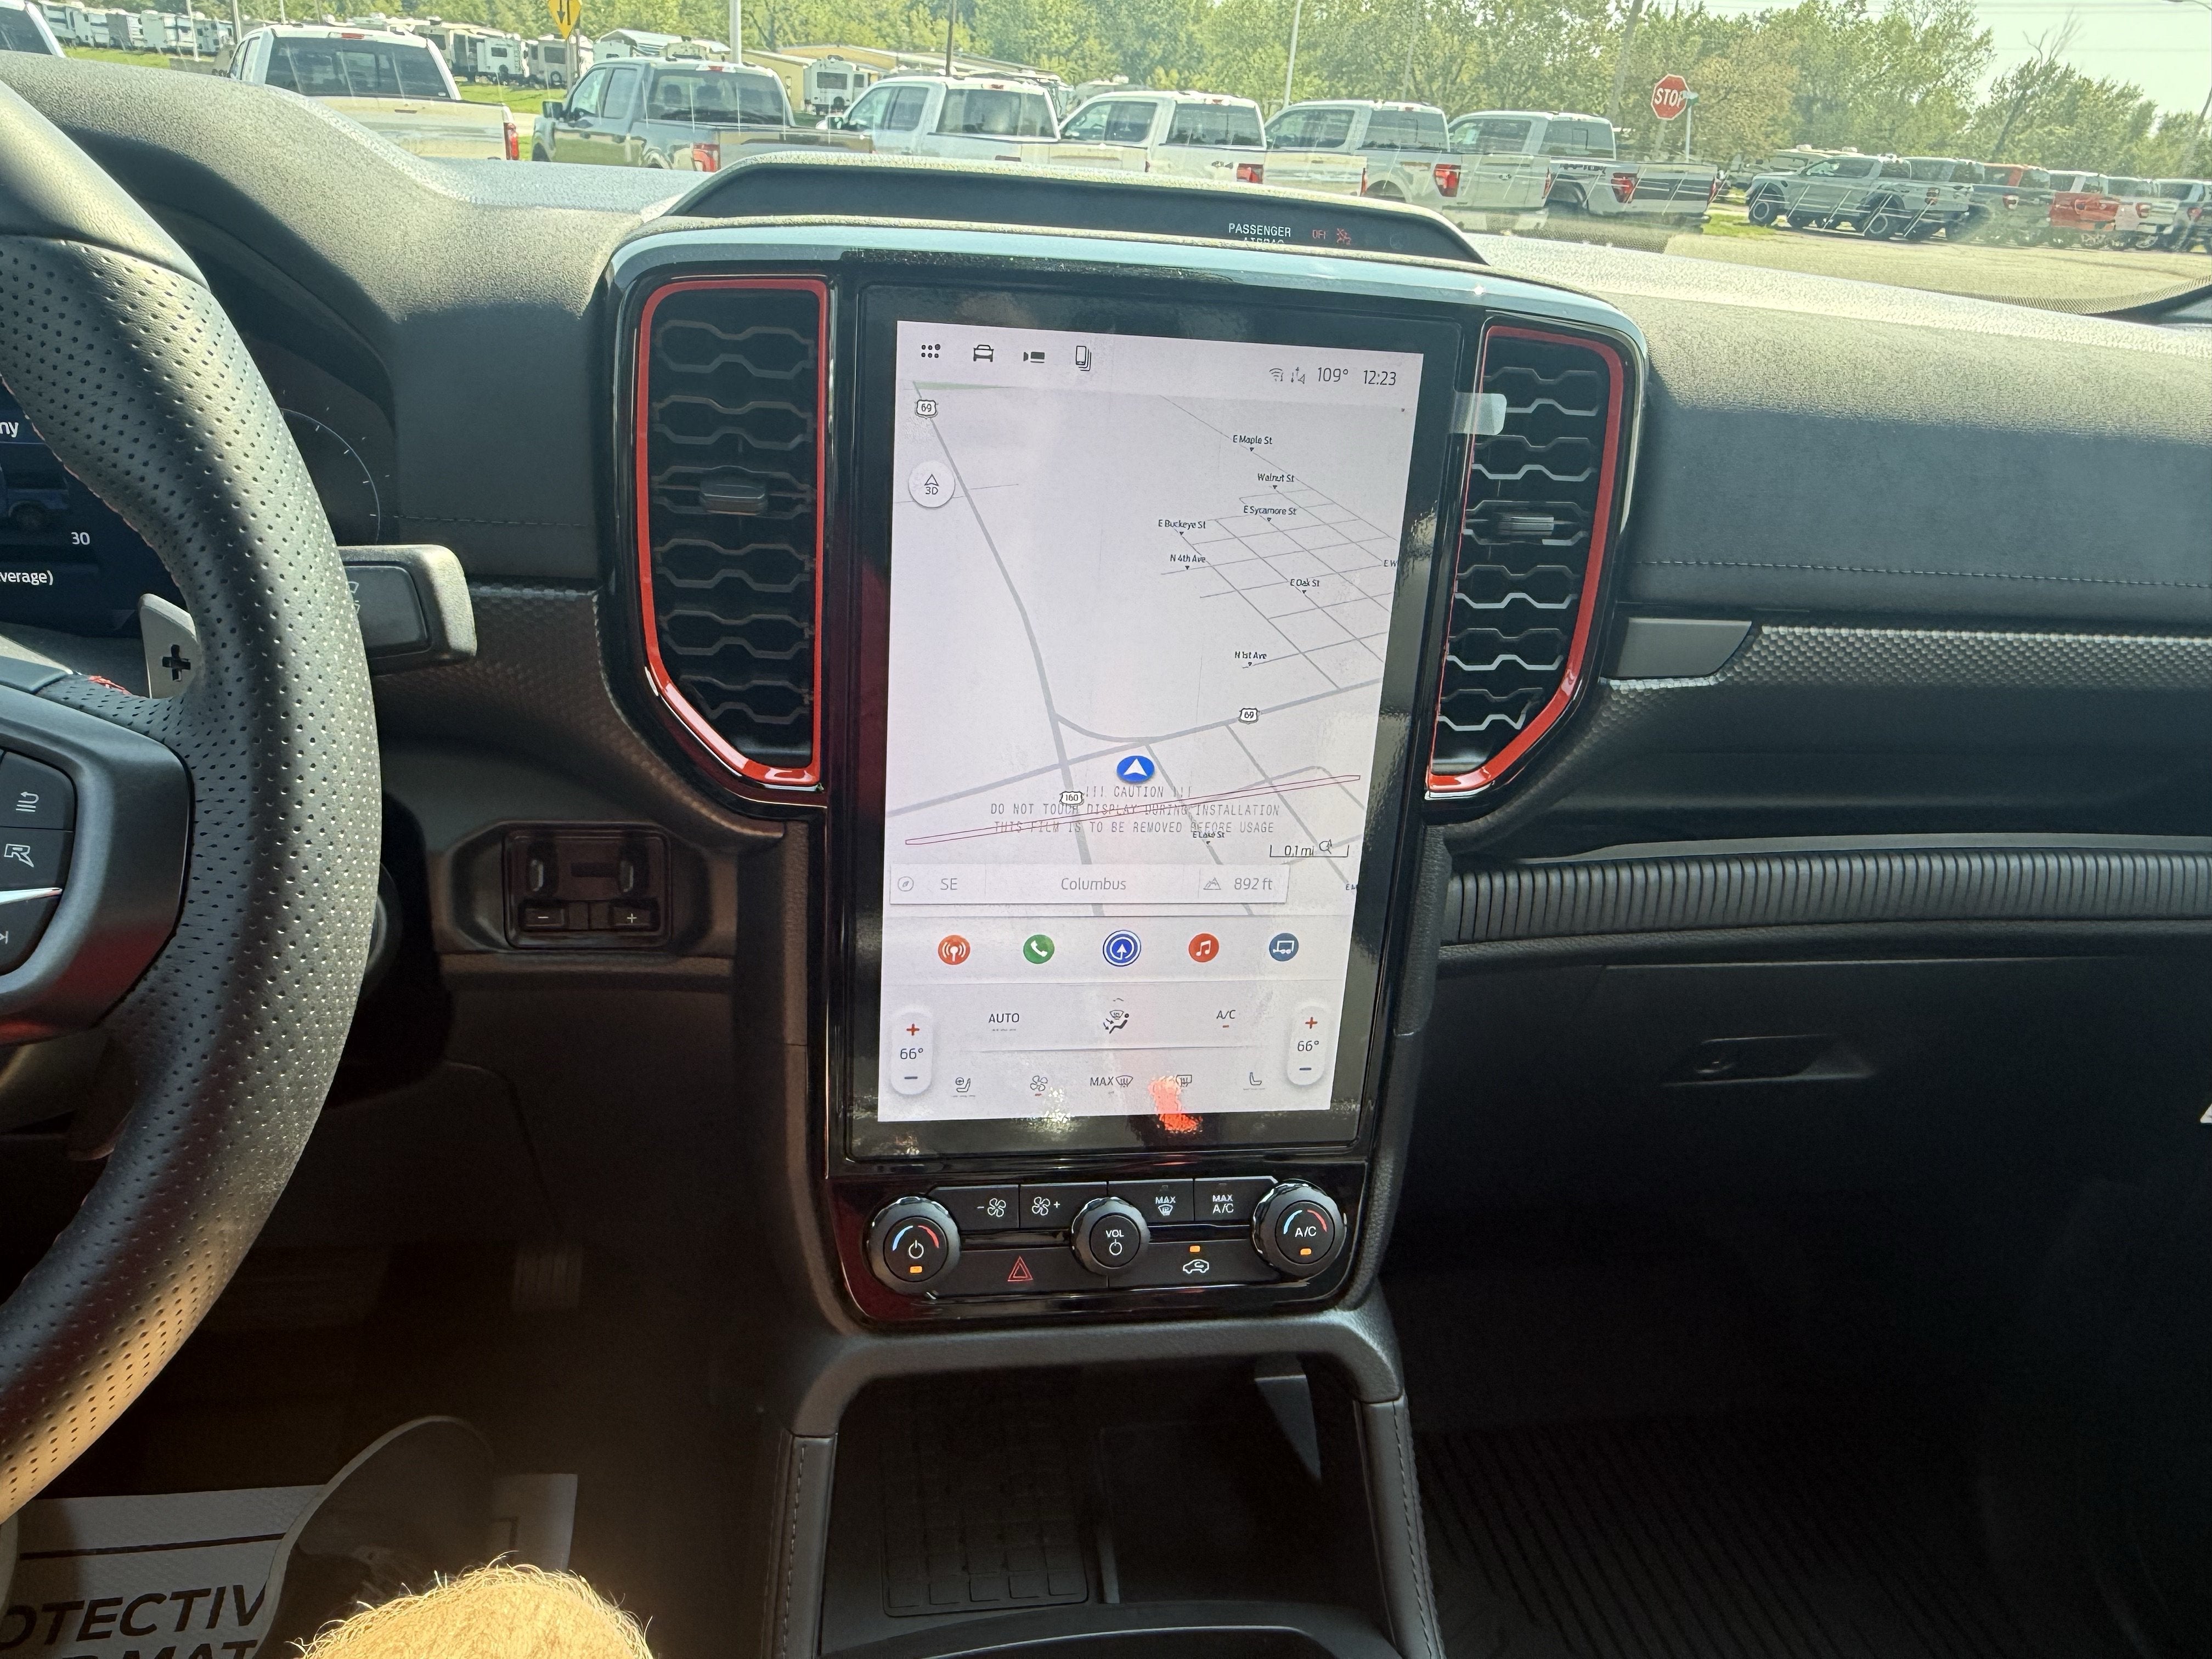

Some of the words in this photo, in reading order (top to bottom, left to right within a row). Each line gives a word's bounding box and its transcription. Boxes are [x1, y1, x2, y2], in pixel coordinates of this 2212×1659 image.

[1655, 88, 1684, 108] STOP
[1228, 223, 1291, 238] PASSENGER
[1318, 366, 1348, 382] 109°
[1363, 370, 1397, 386] 12:23
[921, 403, 932, 412] 69
[1239, 435, 1262, 445] Maple
[1257, 473, 1284, 482] Walnut
[926, 487, 939, 495] 3D
[1244, 505, 1248, 514] E
[1250, 506, 1286, 515] Sycamore
[1165, 520, 1196, 530] Buckeye
[1198, 521, 1206, 529] St
[71, 532, 90, 545] 30
[1178, 554, 1190, 562] 4th
[1192, 555, 1206, 563] Ave
[1296, 578, 1310, 586] Oak
[1114, 786, 1164, 797] CAUTION
[991, 804, 1005, 814] DO
[1013, 804, 1034, 814] NOT
[1043, 804, 1080, 814] TOUCH
[1087, 804, 1138, 815] DISPLAY
[1145, 804, 1187, 815] DURING
[1196, 804, 1280, 815] INSTALLATION
[994, 821, 1023, 833] THIS
[1030, 821, 1059, 833] FILM
[1069, 821, 1081, 833] IS
[1090, 821, 1103, 833] TO
[1111, 821, 1124, 833] BE
[1133, 822, 1182, 833] REMOVED
[1190, 822, 1232, 833] BEFORE
[1240, 822, 1274, 833] USAGE
[1284, 845, 1298, 856] 0.1
[1301, 845, 1314, 856] mi
[940, 878, 958, 890] SE
[1060, 877, 1126, 890] Columbus
[1234, 878, 1259, 890] 892
[1263, 878, 1273, 890] ft
[988, 1013, 1020, 1023] AUTO
[1216, 1009, 1236, 1019] A/C
[1297, 1040, 1319, 1052] 66°
[900, 1048, 924, 1059] 66°
[1090, 1076, 1114, 1086] MAX
[1155, 1195, 1176, 1204] MAX
[1212, 1194, 1233, 1202] MAX
[1212, 1203, 1234, 1214] A/C
[1105, 1229, 1125, 1238] VOL
[1295, 1226, 1317, 1238] A/C
